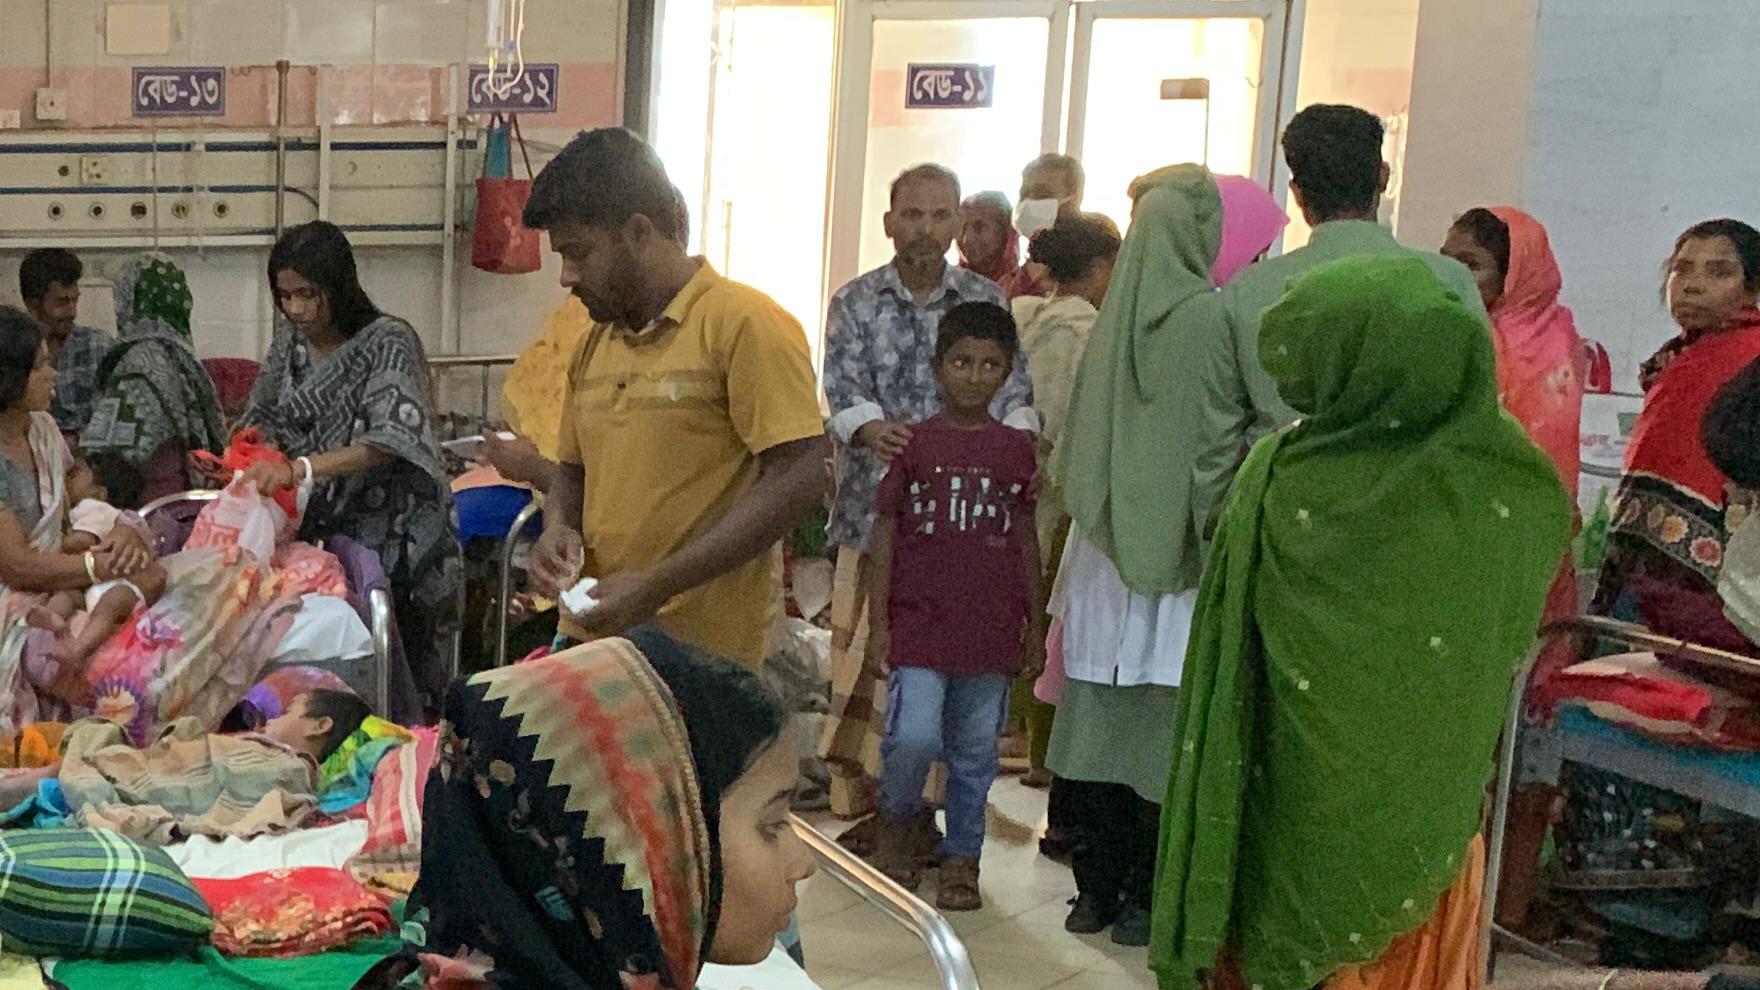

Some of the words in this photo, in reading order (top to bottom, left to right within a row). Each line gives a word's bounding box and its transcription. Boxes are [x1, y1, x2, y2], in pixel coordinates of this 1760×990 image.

[139, 75, 219, 107] বেড-১৩
[472, 72, 551, 105] বেড-১২
[913, 70, 987, 101] বেড-১১
